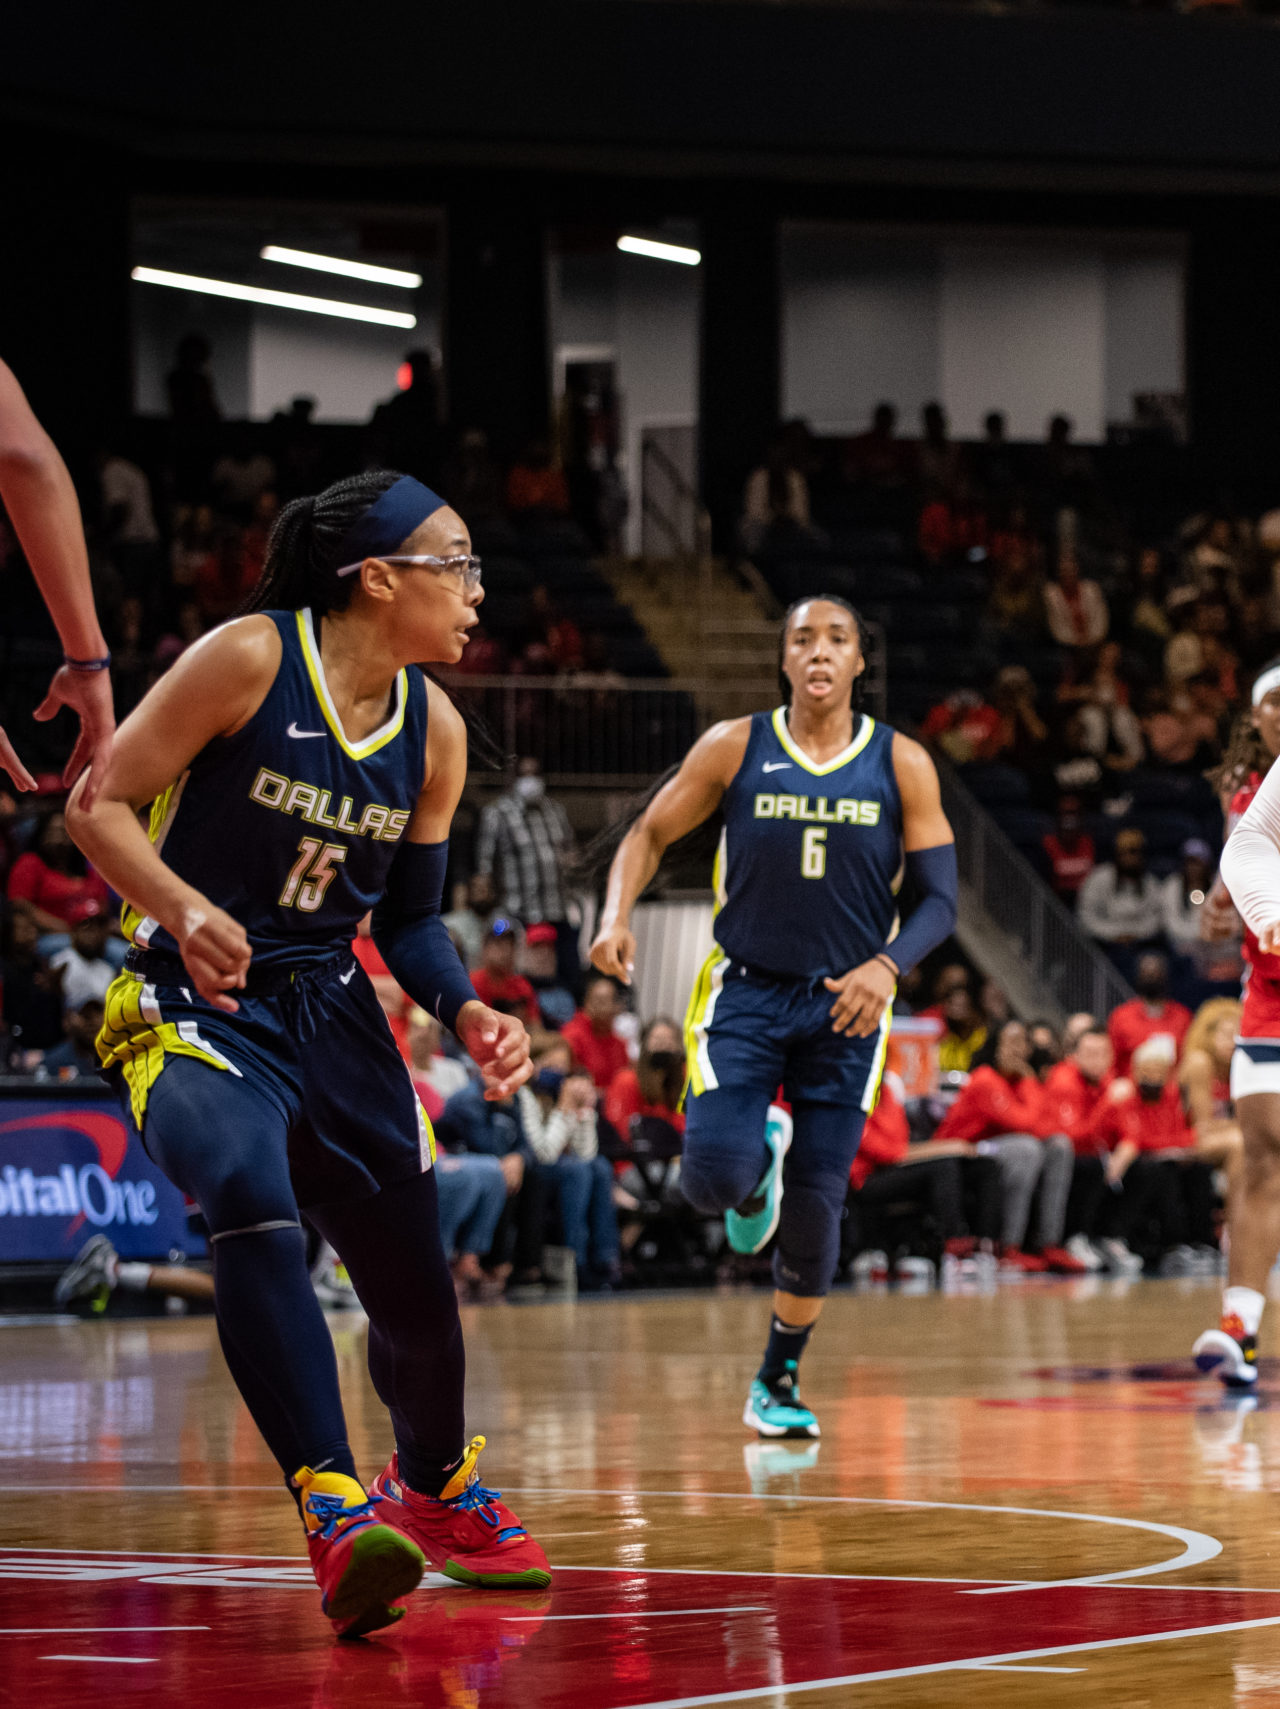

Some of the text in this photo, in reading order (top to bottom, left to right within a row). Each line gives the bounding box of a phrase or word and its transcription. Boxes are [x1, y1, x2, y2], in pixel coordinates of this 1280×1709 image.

[249, 767, 411, 842] DALLAS
[754, 793, 881, 827] DALLAS
[278, 836, 348, 913] 15
[801, 826, 828, 880] 6
